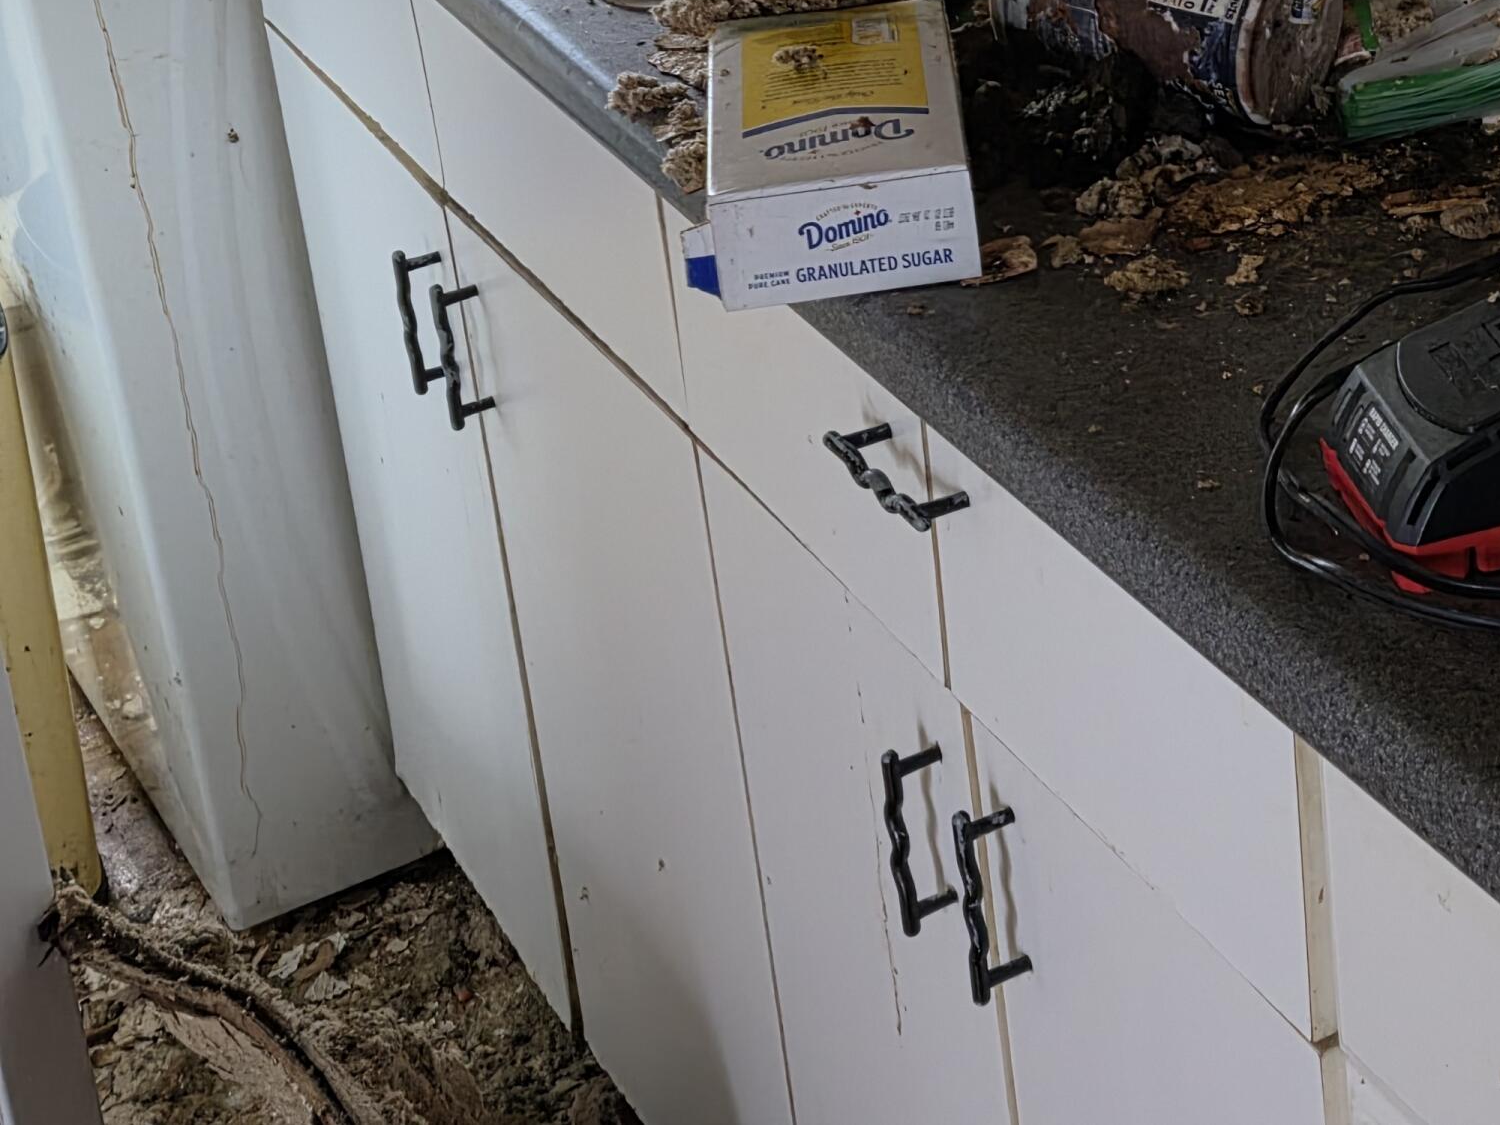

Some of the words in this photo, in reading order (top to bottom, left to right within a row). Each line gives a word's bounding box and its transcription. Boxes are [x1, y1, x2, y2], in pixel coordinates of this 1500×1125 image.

[764, 118, 915, 161] Domino
[797, 208, 890, 250] Domino
[770, 278, 791, 288] CANE
[796, 255, 898, 284] GRANULATED
[901, 247, 955, 269] SUGAR
